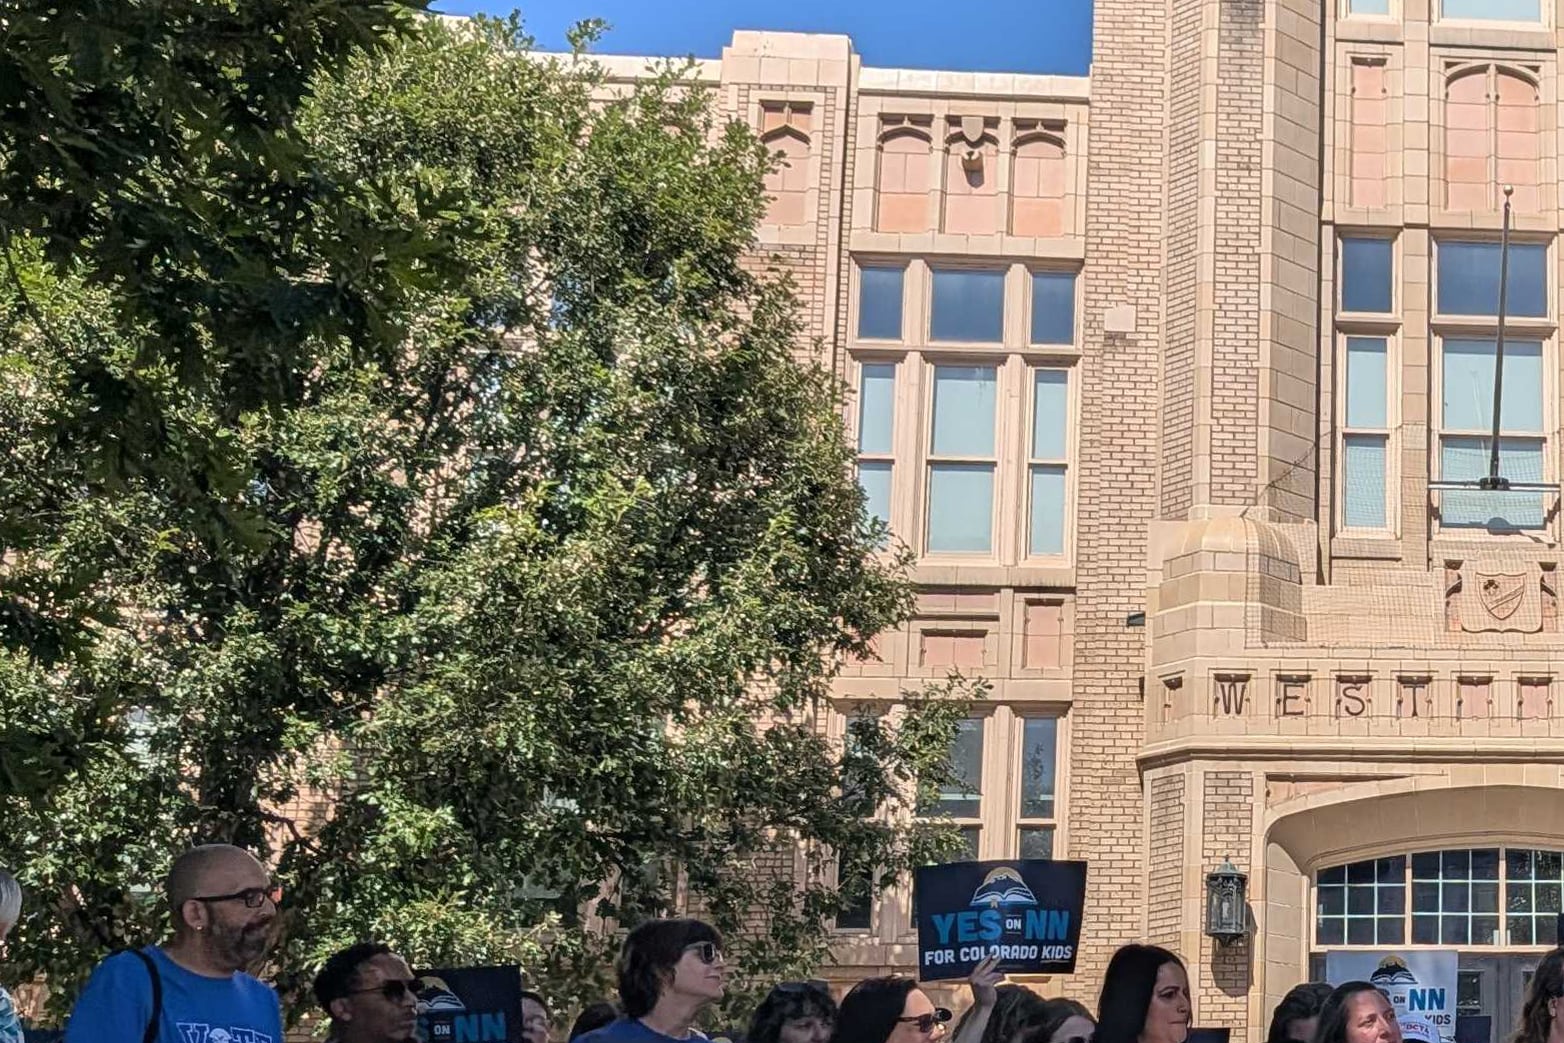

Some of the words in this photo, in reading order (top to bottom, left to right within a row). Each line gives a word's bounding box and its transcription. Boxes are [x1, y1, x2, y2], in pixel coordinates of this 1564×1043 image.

[1214, 684, 1426, 717] WEST
[931, 910, 1002, 944] YES
[1005, 919, 1022, 929] ON
[1026, 910, 1070, 940] NN
[924, 950, 956, 965] FOR
[1041, 945, 1072, 959] KIDS
[1409, 988, 1445, 1011] NN
[433, 1024, 450, 1036] ON
[455, 1012, 507, 1042] NN
